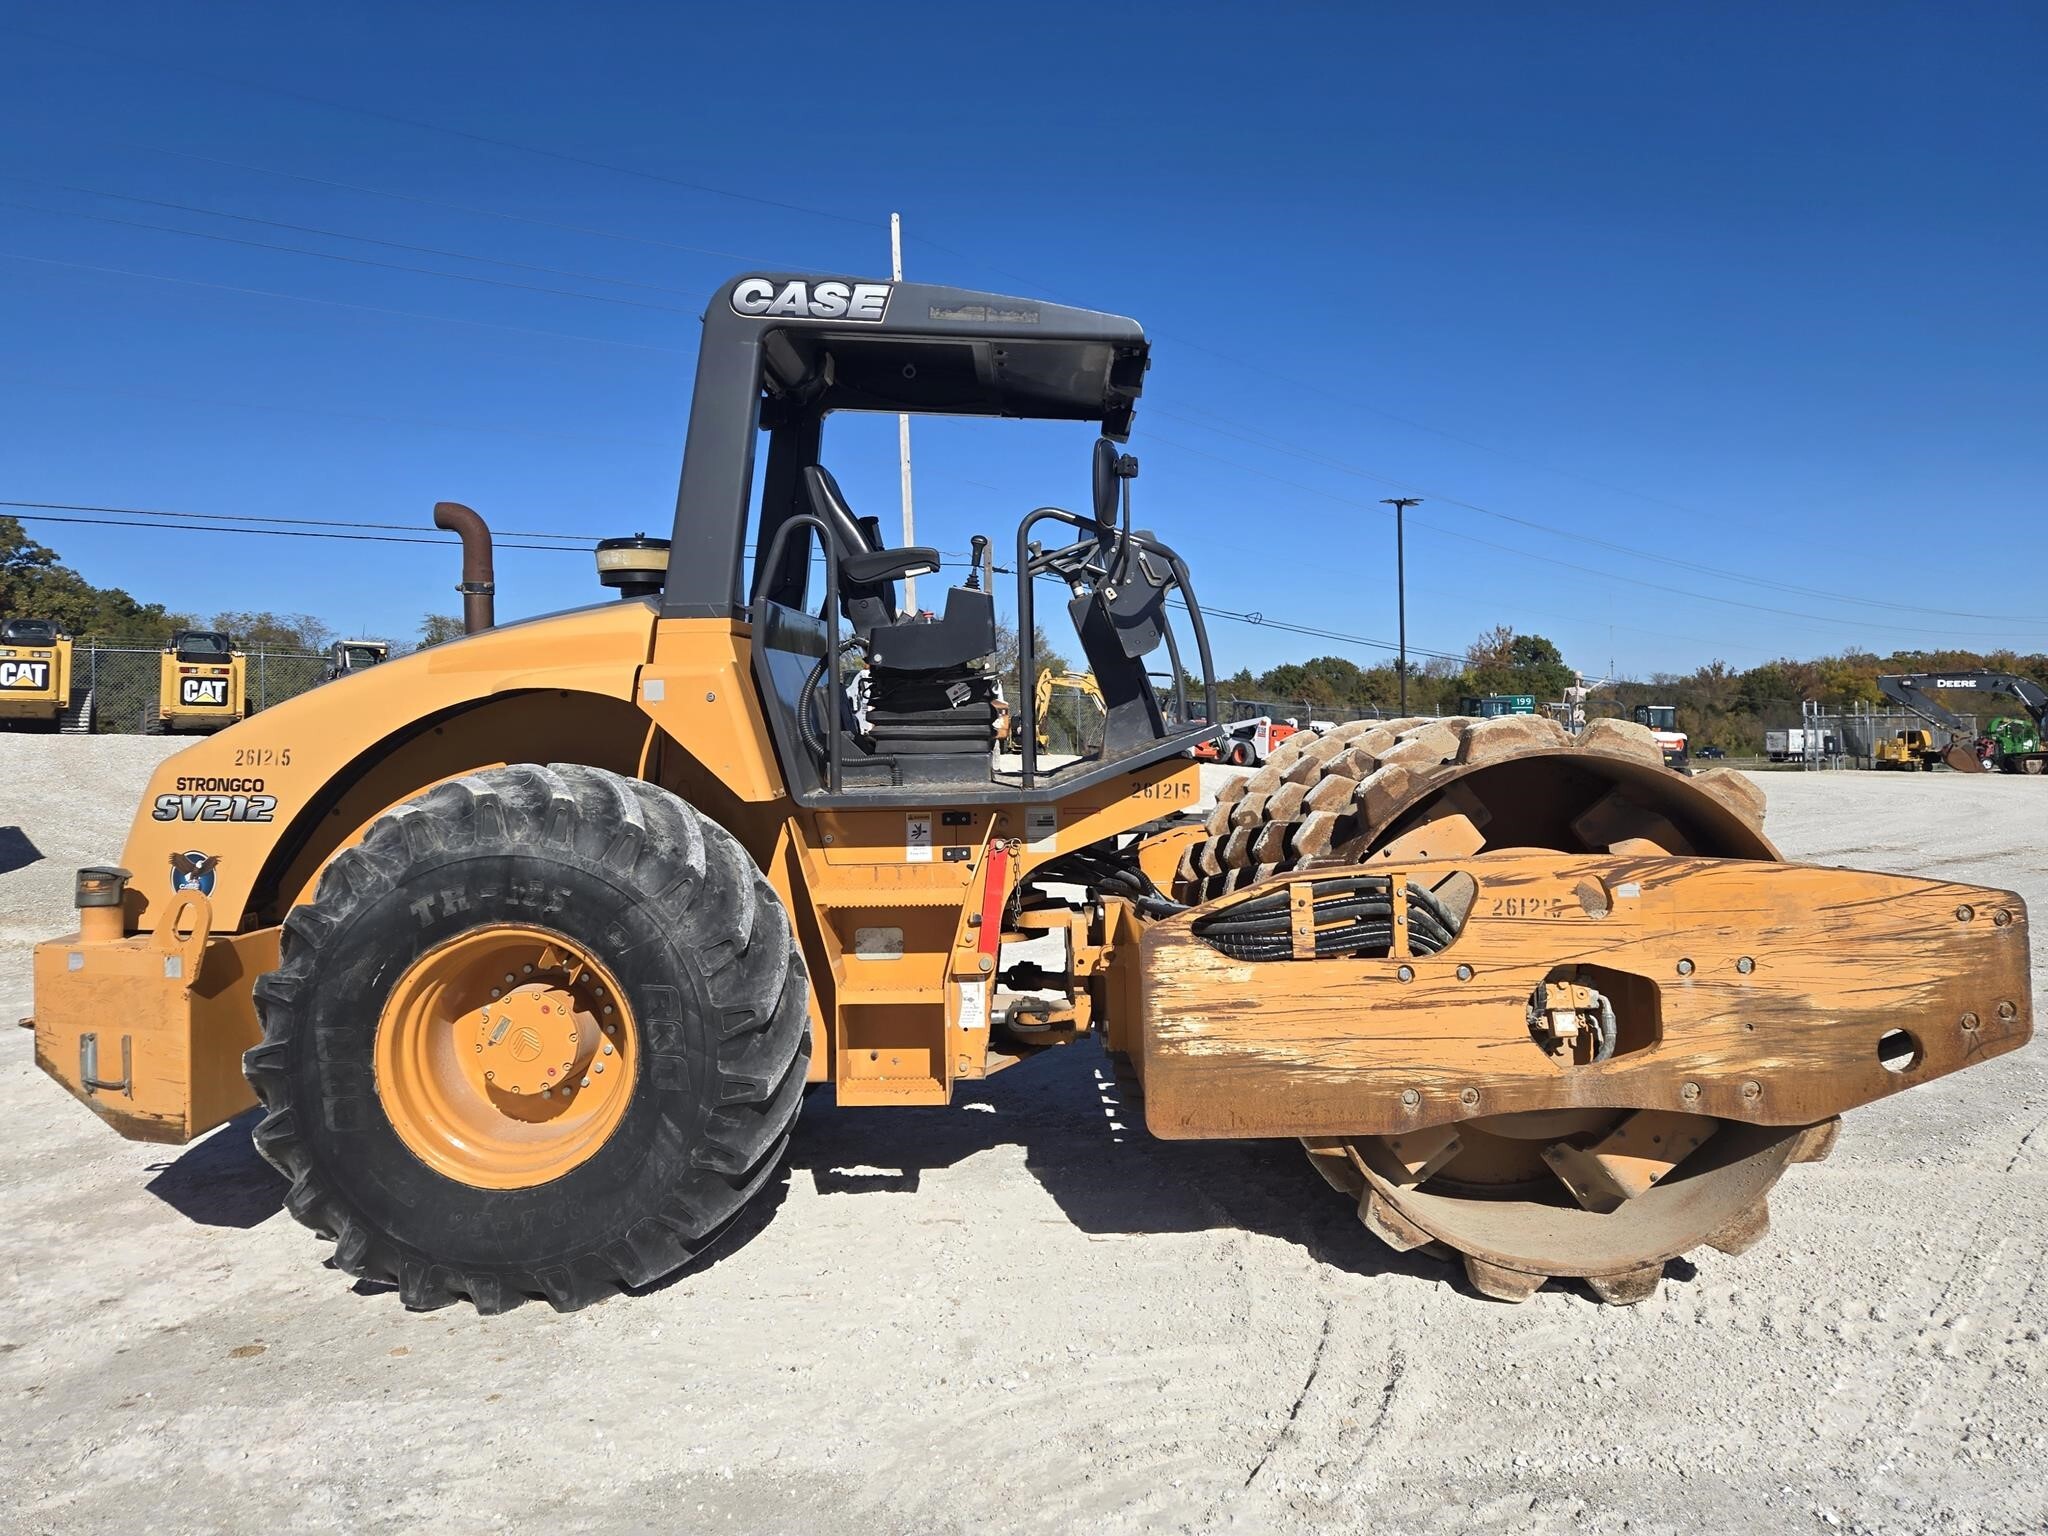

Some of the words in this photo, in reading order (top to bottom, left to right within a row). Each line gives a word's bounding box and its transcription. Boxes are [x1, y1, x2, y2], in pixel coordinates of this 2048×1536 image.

[731, 278, 892, 319] CASE
[0, 662, 47, 687] CAT
[1937, 679, 1977, 688] DEERE
[183, 679, 227, 703] CAT
[1516, 697, 1532, 706] 199
[235, 748, 291, 767] 261215
[176, 777, 265, 793] STRONGCO
[1132, 781, 1191, 800] 261215
[152, 793, 278, 822] SV212
